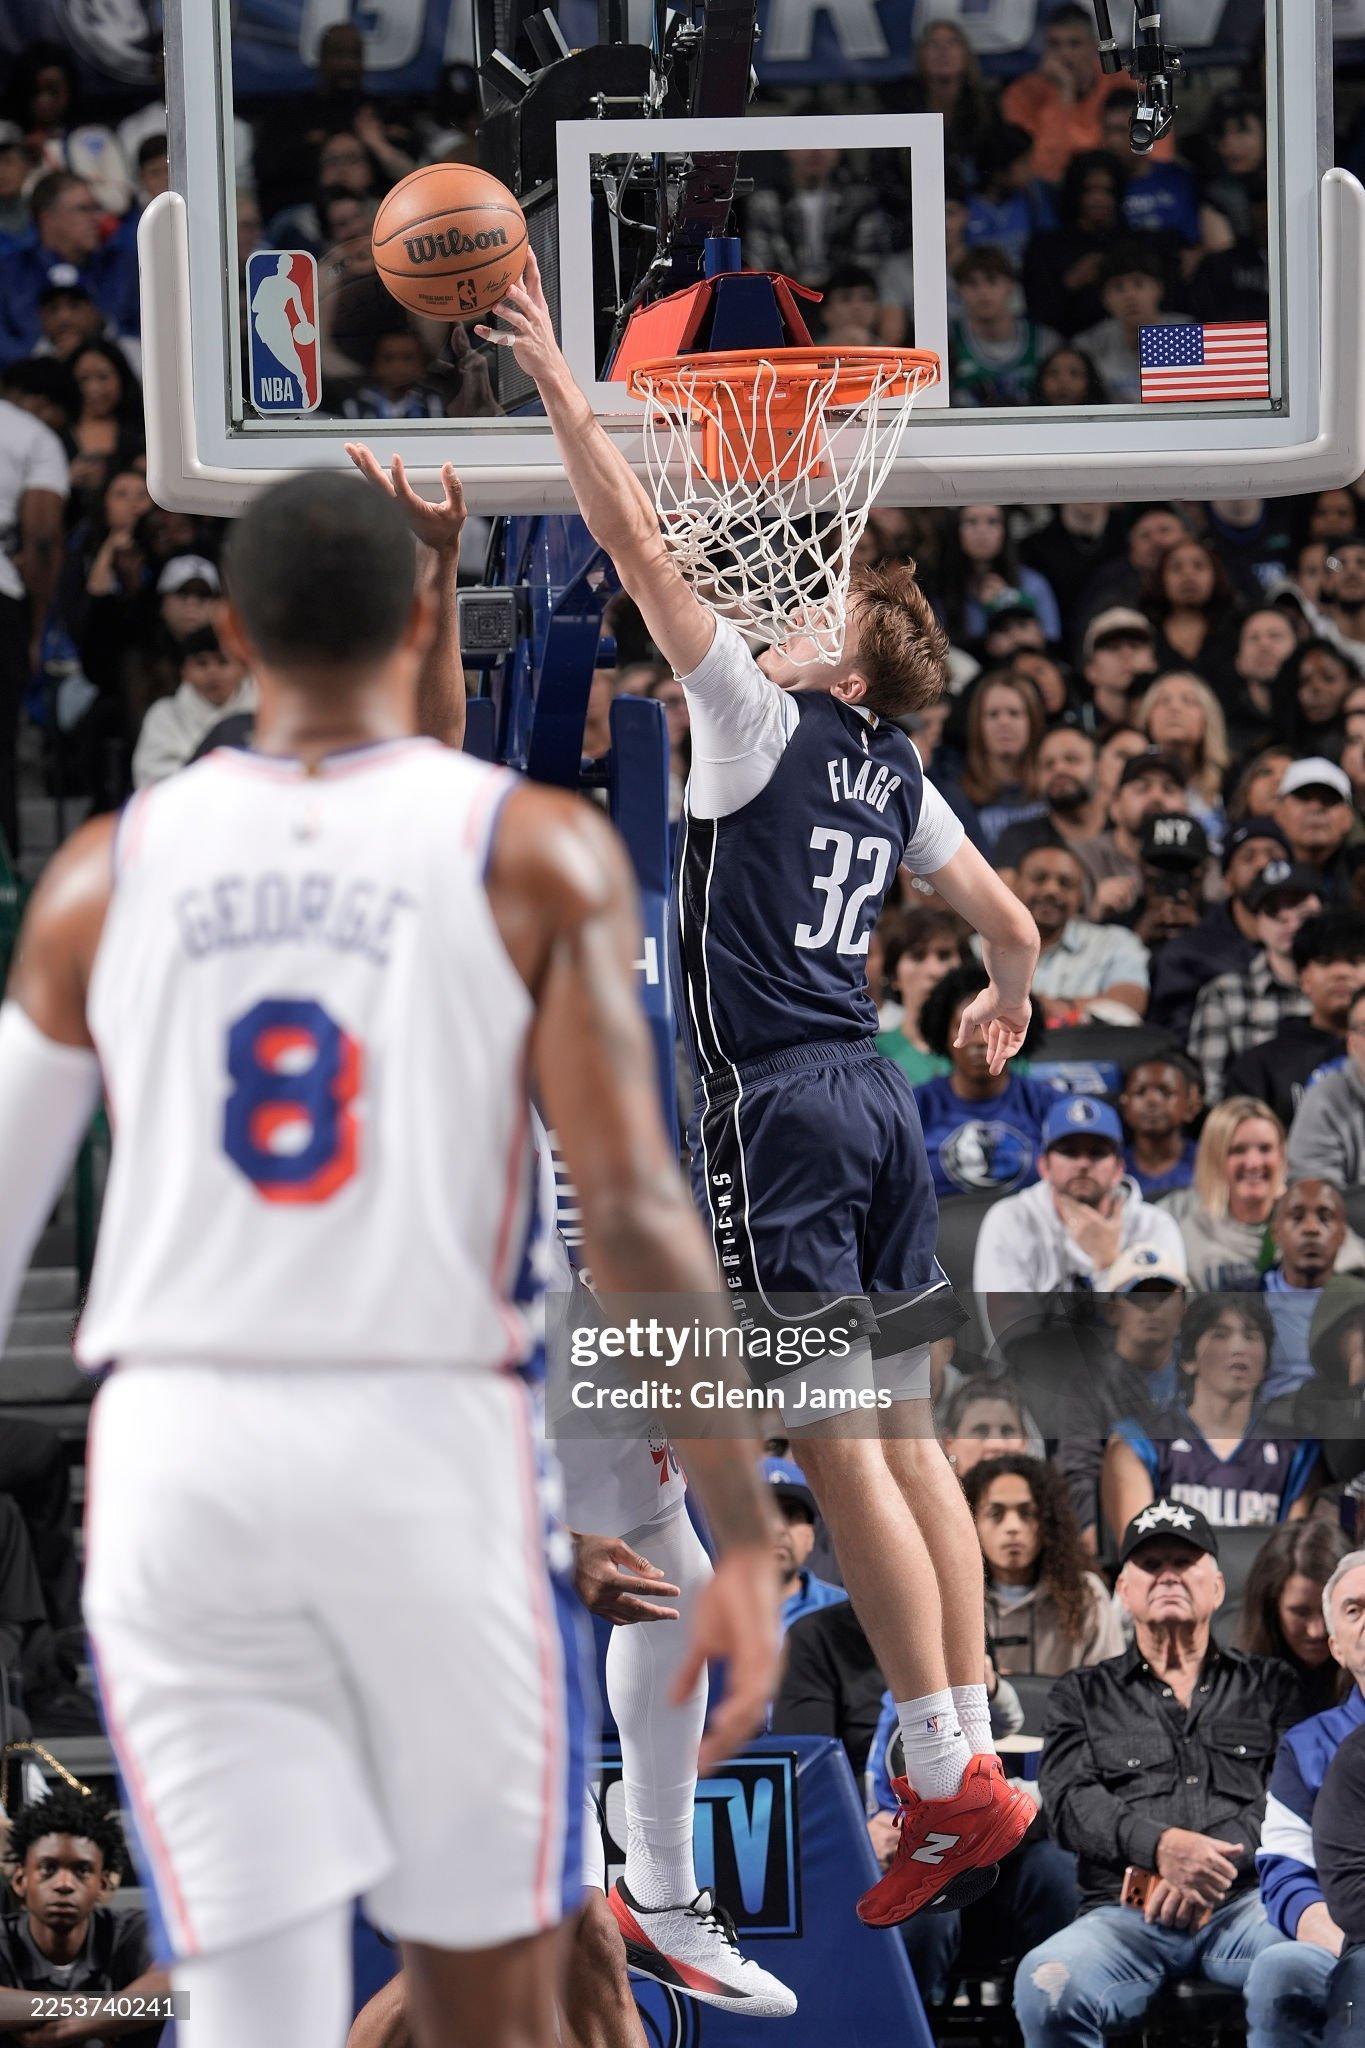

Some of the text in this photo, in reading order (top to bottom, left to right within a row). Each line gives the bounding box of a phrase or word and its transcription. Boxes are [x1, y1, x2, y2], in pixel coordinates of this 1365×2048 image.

[403, 226, 508, 264] Wilson
[261, 377, 295, 402] NBA
[827, 757, 902, 813] FLAGG
[1153, 817, 1194, 847] NY
[794, 826, 892, 955] 32
[222, 998, 363, 1205] 8
